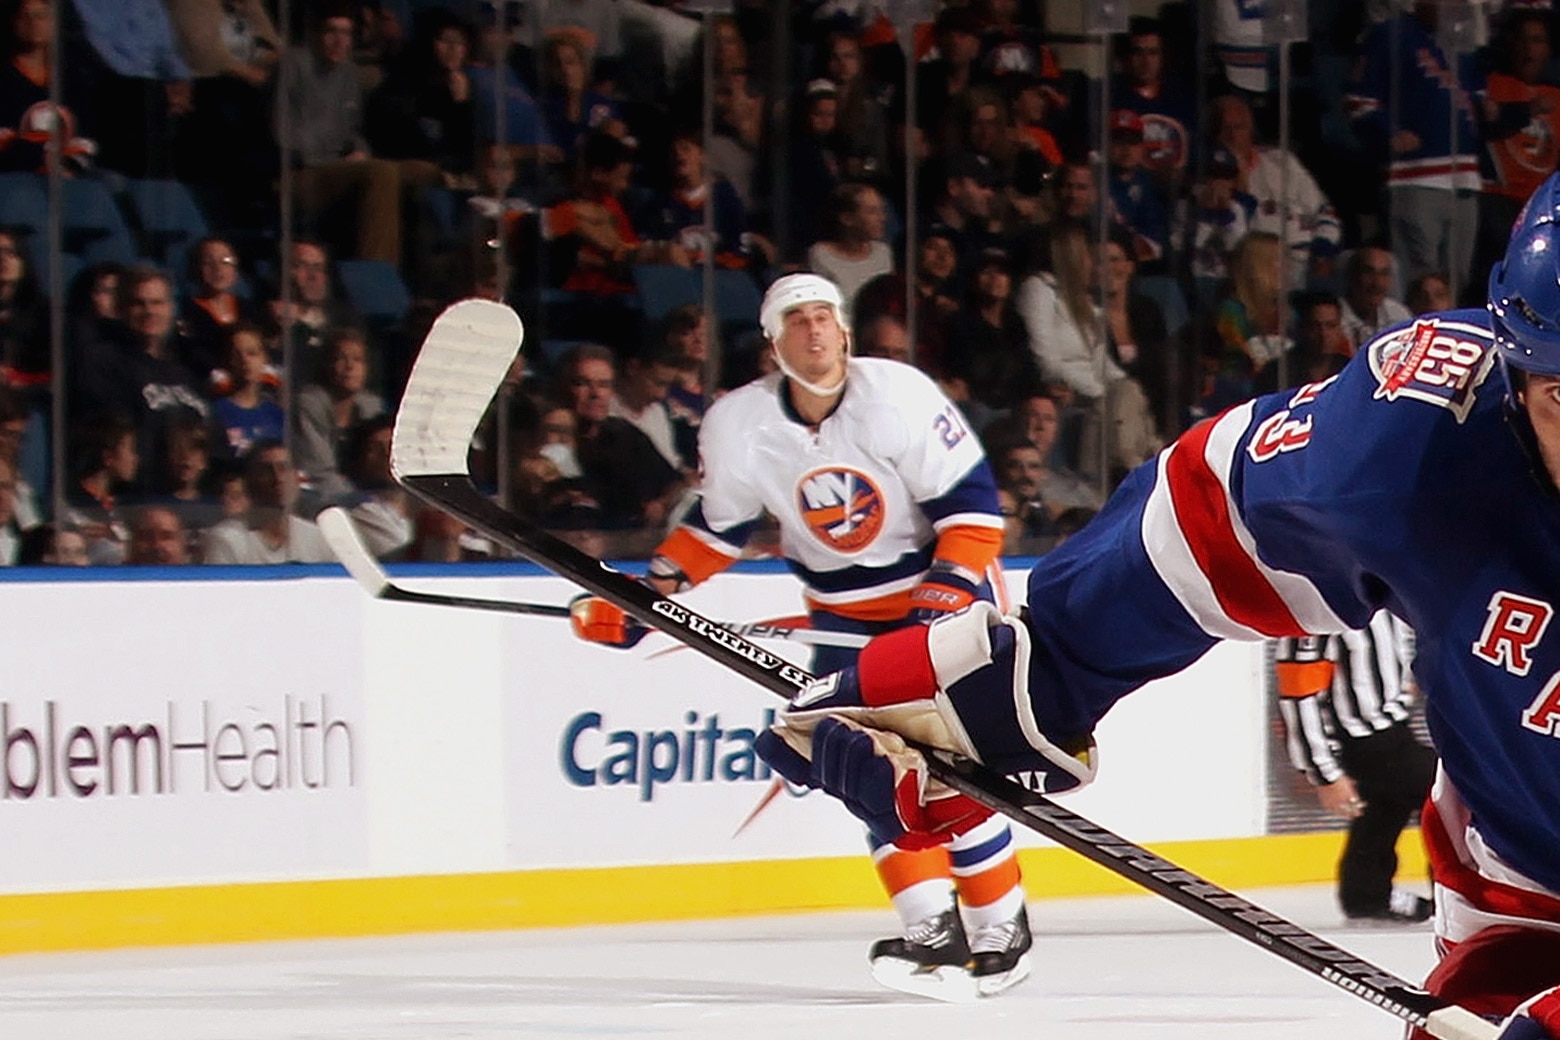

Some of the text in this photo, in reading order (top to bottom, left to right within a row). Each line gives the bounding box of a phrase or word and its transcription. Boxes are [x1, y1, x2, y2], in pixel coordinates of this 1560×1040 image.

[652, 600, 690, 624] AK
[688, 616, 783, 670] TWENTY
[559, 706, 777, 801] Capital
